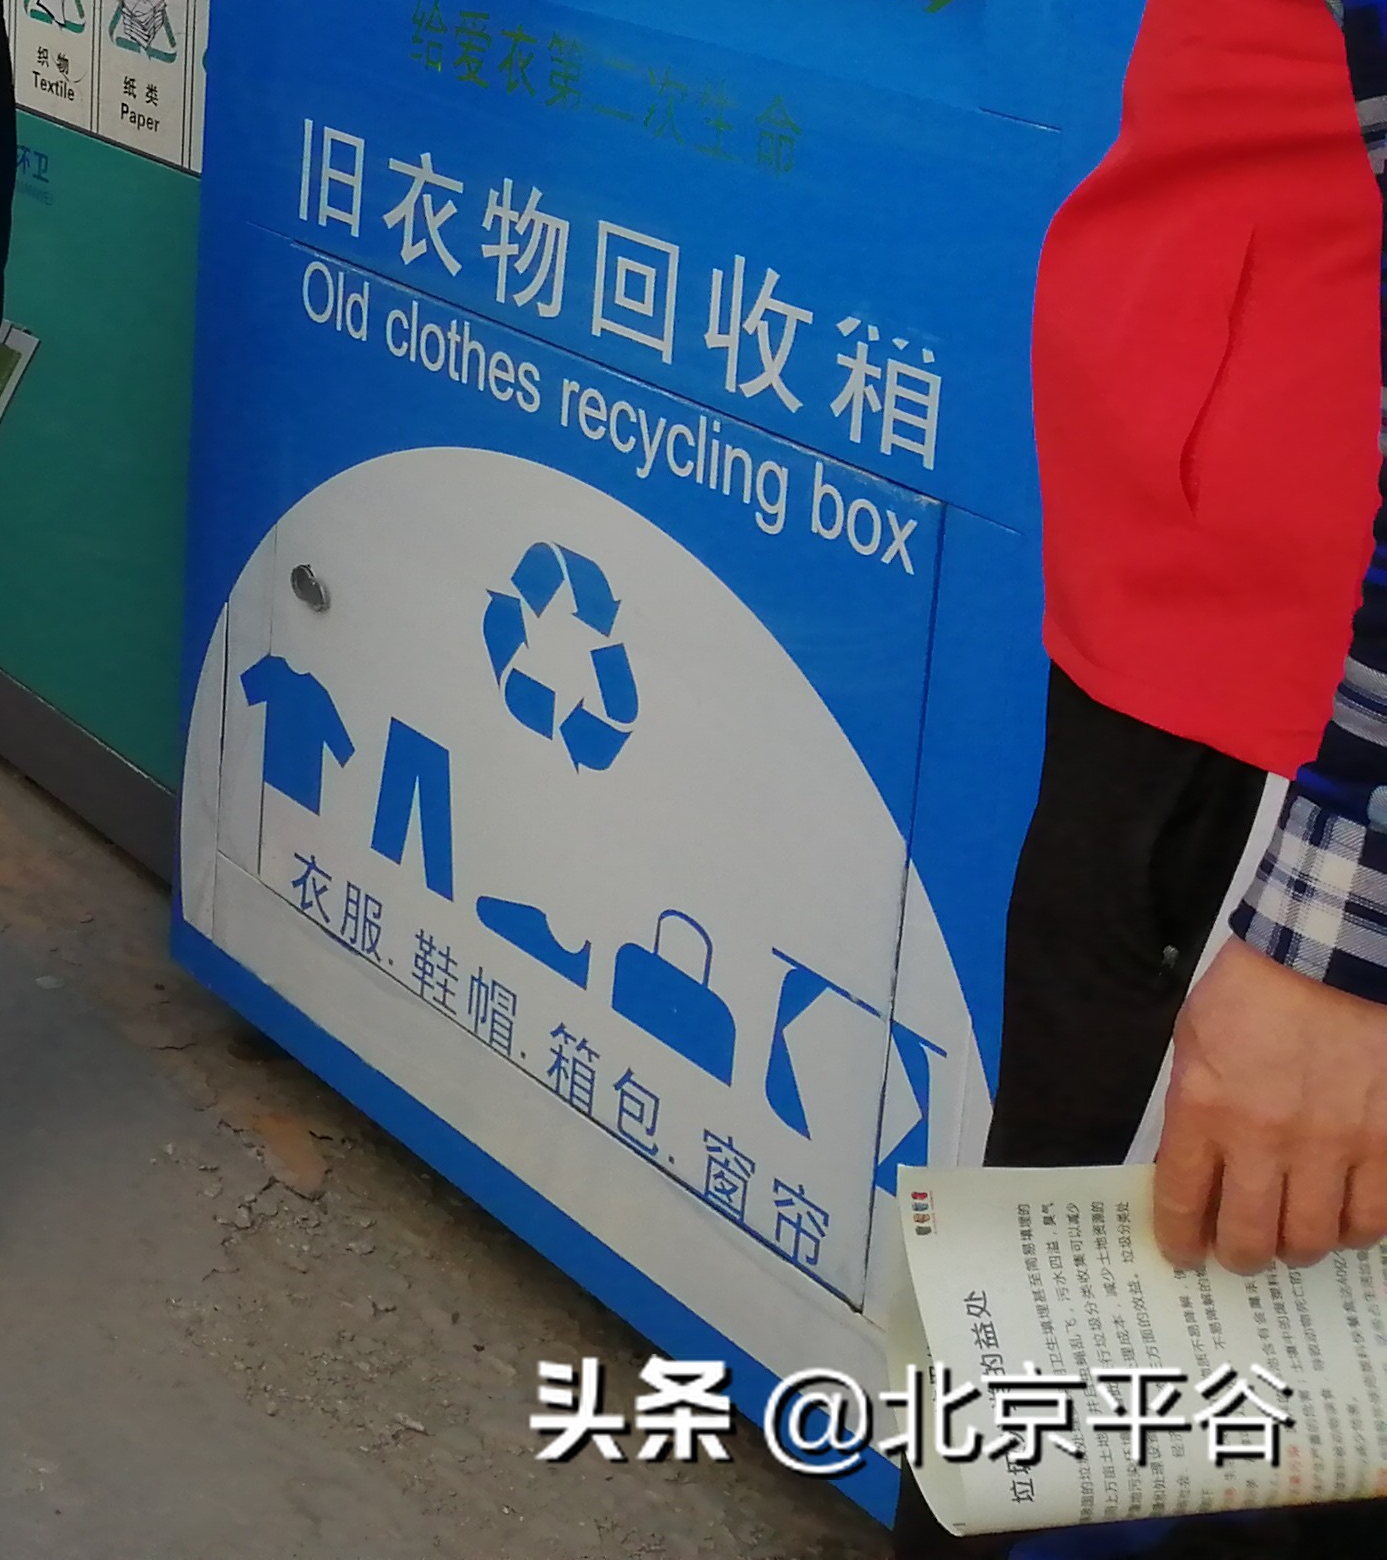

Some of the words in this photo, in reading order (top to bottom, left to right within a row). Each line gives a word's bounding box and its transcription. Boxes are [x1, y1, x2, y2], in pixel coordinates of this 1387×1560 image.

[36, 44, 71, 78] 织物
[31, 68, 77, 104] Textile
[122, 76, 159, 107] 纸类
[119, 101, 161, 135] Paper
[298, 118, 943, 471] 旧衣物回收箱
[301, 260, 371, 343] Old
[385, 307, 542, 414] clothes
[560, 374, 789, 537] recycling
[811, 460, 919, 577] box
[963, 1290, 1035, 1504] 垃圾的益处
